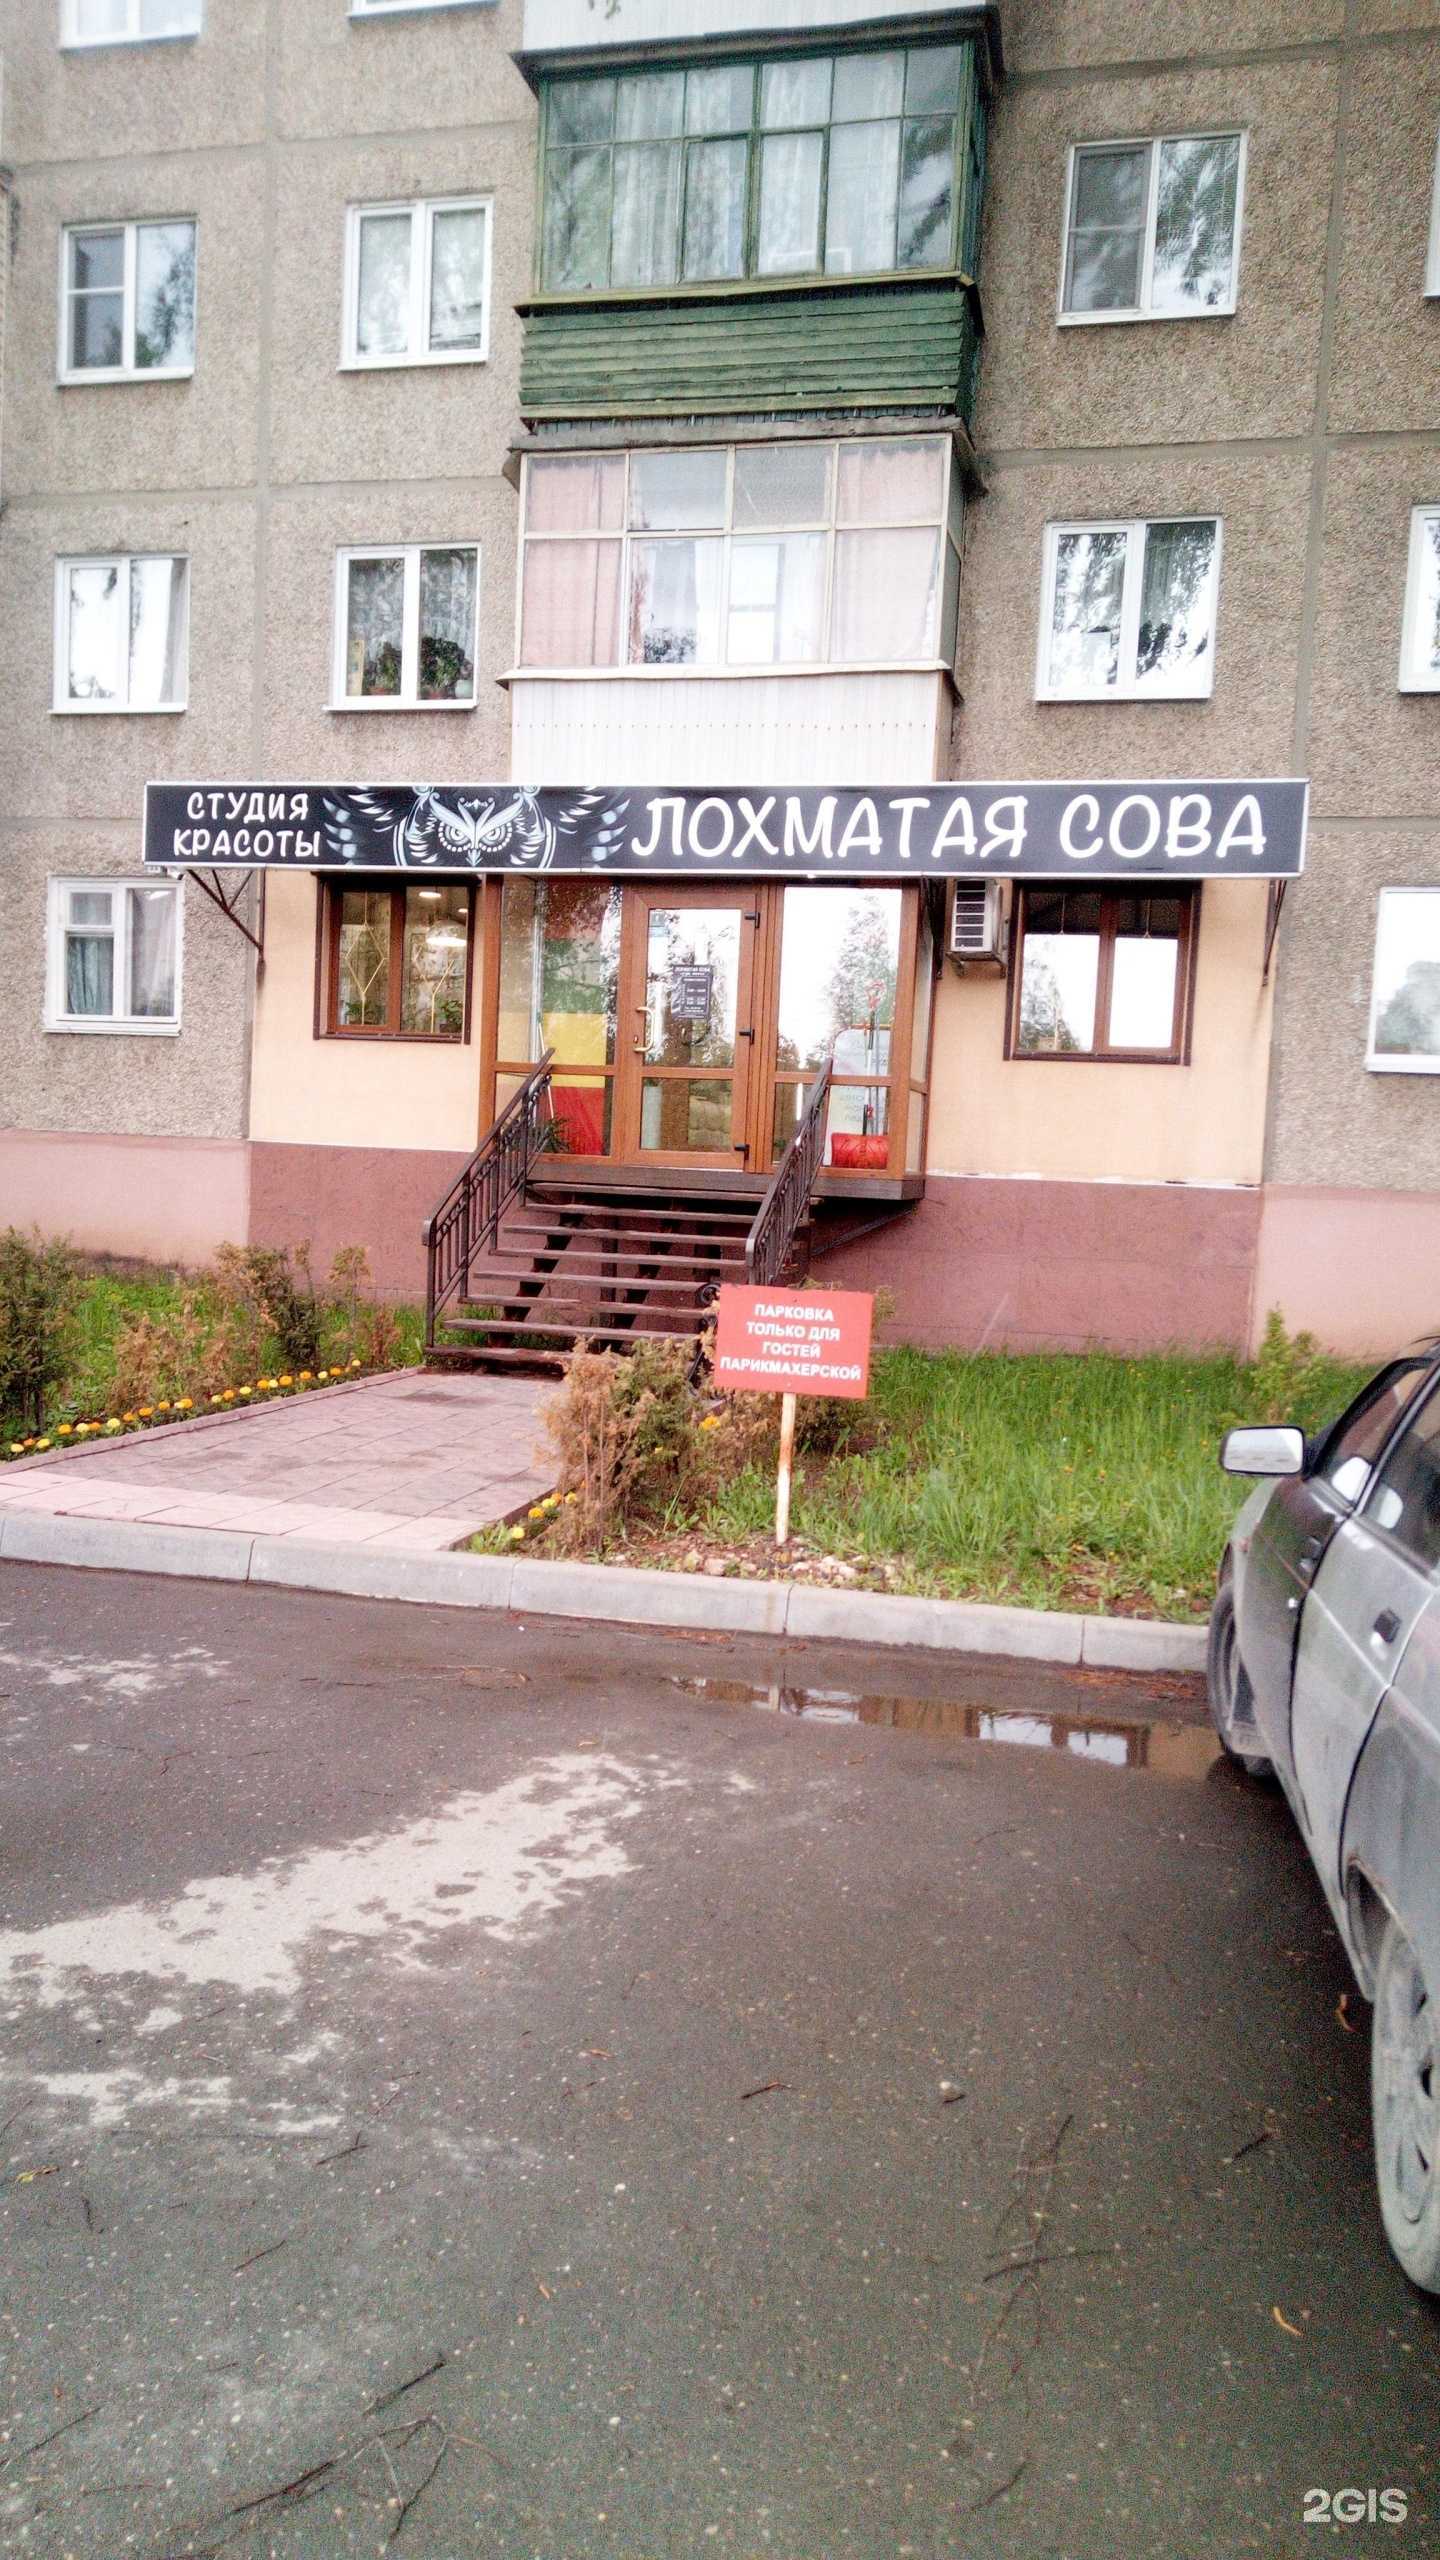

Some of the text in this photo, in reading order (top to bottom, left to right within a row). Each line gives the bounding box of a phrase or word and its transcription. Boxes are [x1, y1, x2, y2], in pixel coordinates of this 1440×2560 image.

[187, 791, 309, 823] СТУДИЯ
[631, 793, 1267, 858] ЛОХМАТАЯ СОВА
[173, 828, 321, 858] КРАСОТЫ
[754, 1303, 835, 1322] ПАРКОВКА
[746, 1321, 841, 1342] ТОЛЬКО ДЛЯ
[762, 1341, 822, 1358] ГОСТЕЙ
[719, 1356, 862, 1381] ПАРИКМАХЕРСКОЙ
